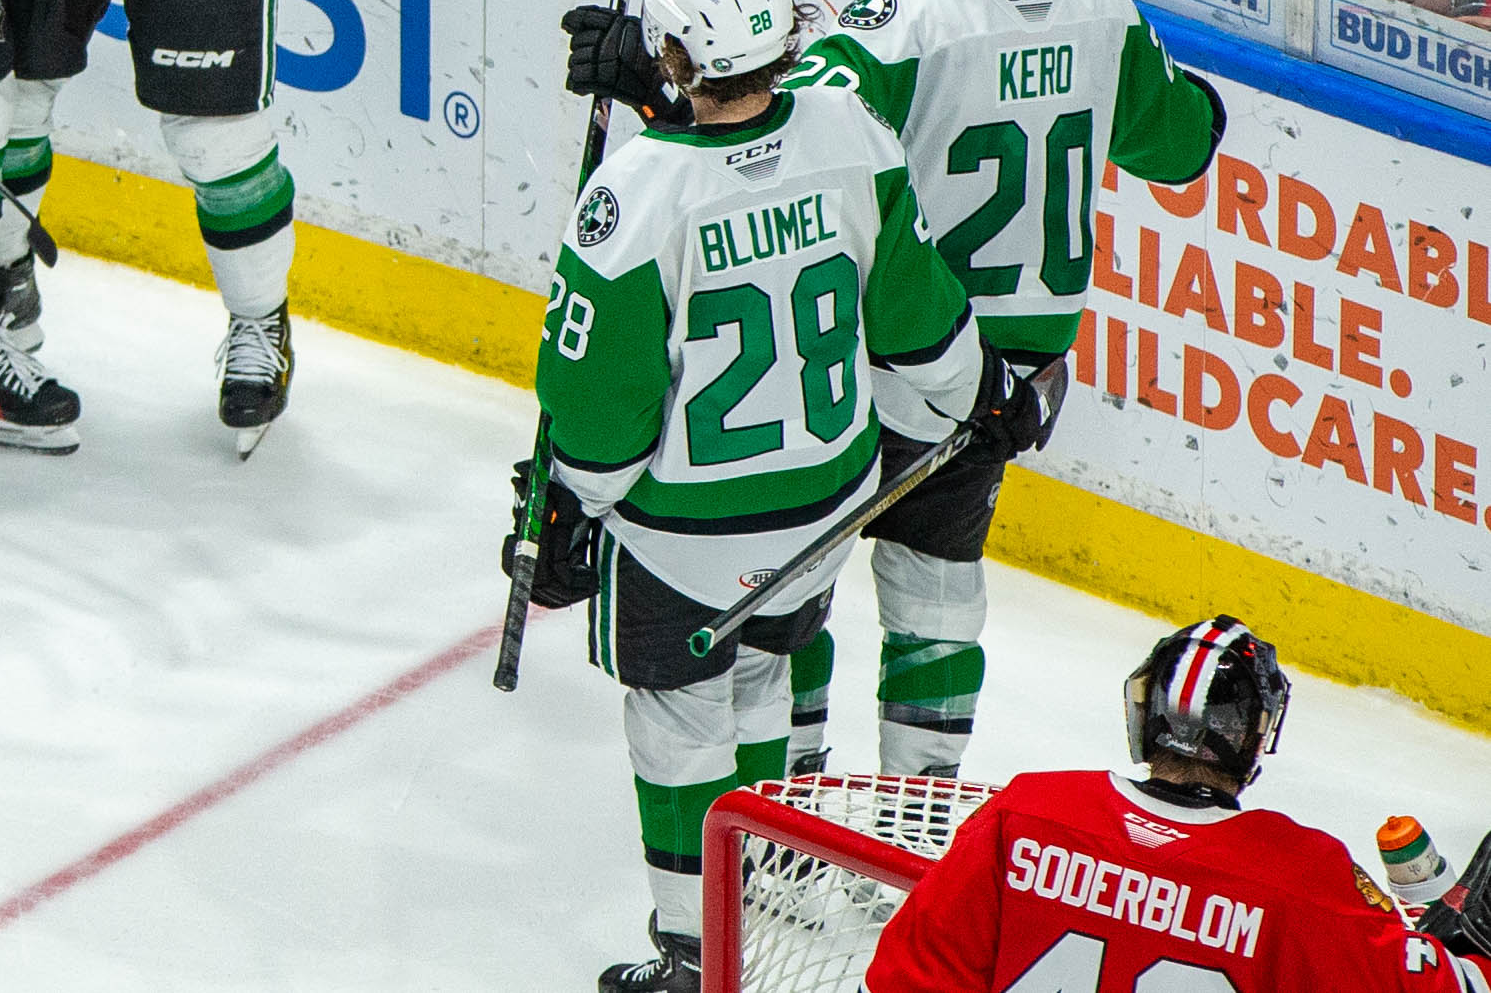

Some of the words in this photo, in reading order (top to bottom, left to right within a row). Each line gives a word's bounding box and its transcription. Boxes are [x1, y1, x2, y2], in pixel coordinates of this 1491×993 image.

[749, 9, 773, 36] 28
[1338, 7, 1412, 60] BUD
[152, 48, 236, 68] CCM
[998, 44, 1073, 102] KERO
[726, 139, 783, 166] CCM
[935, 108, 1093, 297] 20
[698, 193, 838, 273] BLUMEL
[1092, 209, 1413, 398] LIABLE.
[684, 252, 860, 467] 28
[1123, 812, 1191, 840] CCM
[1006, 836, 1265, 959] SODERBLOM
